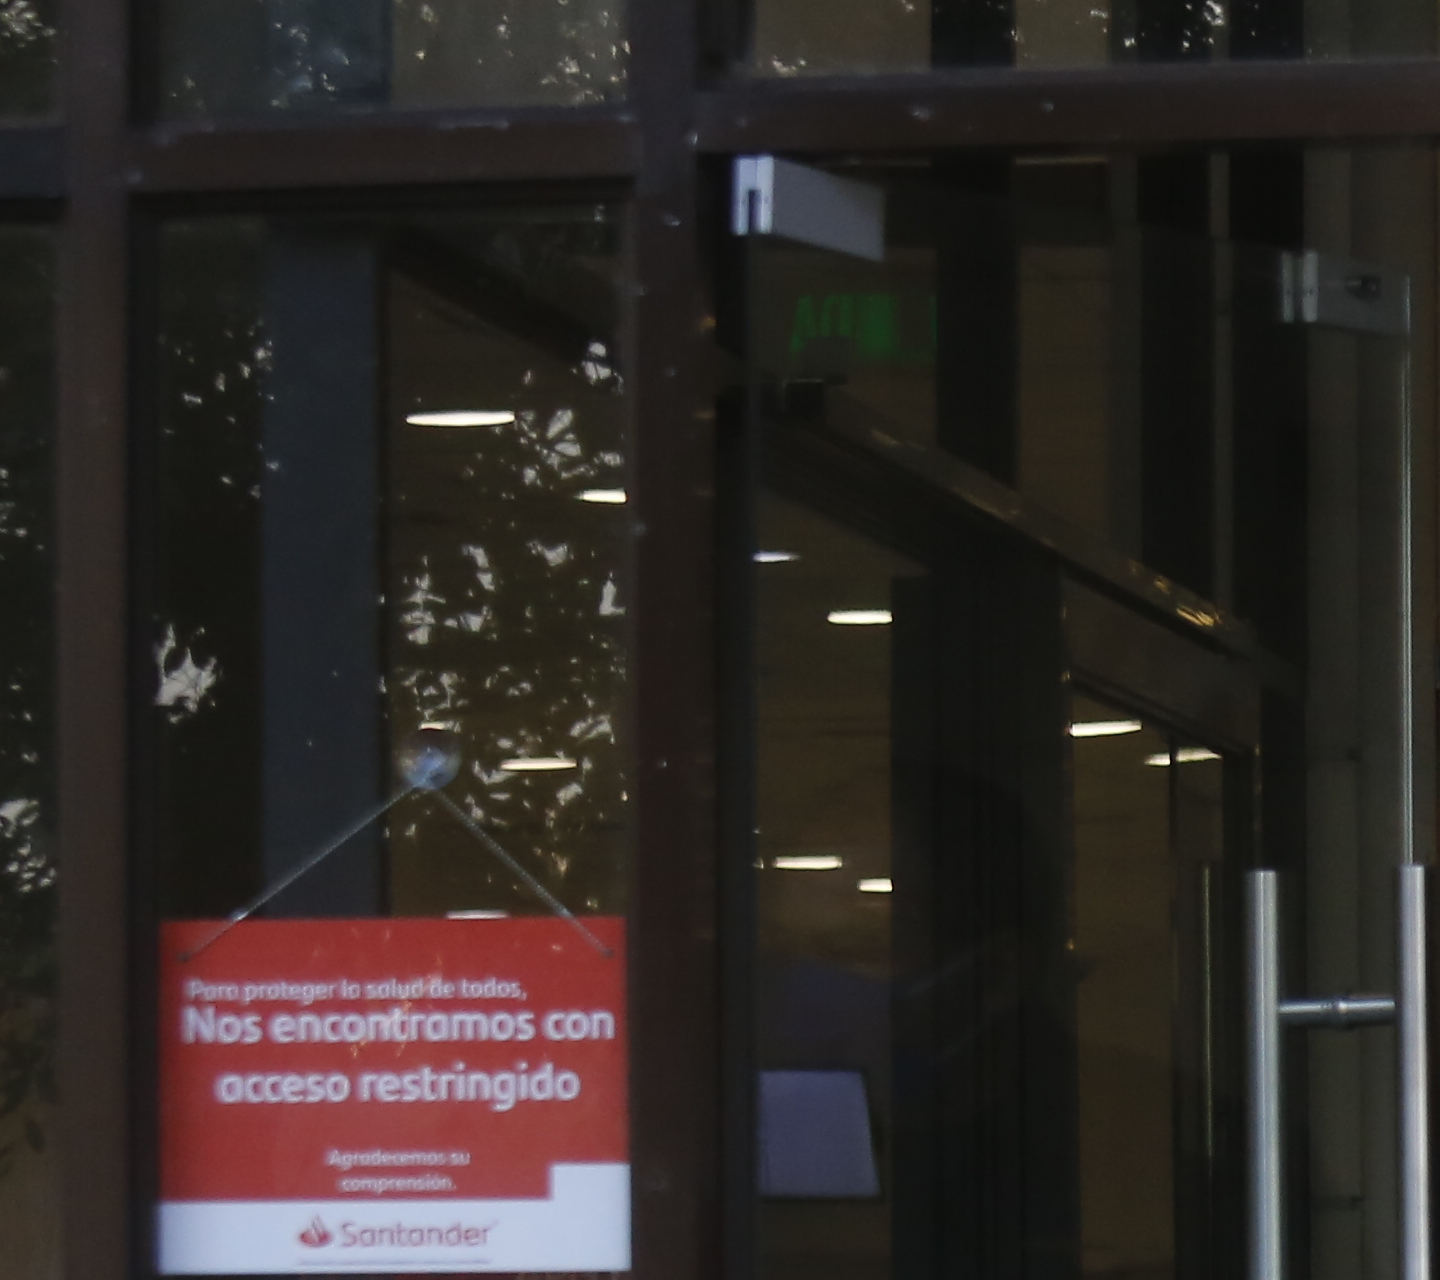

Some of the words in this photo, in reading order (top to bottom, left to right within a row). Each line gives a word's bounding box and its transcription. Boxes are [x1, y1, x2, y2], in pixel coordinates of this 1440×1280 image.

[186, 980, 235, 1000] Para
[243, 981, 334, 1005] proteger
[339, 980, 361, 999] la
[366, 978, 423, 999] salud
[428, 980, 455, 999] de
[460, 979, 527, 1000] todos,
[182, 1007, 263, 1043] Nos
[274, 1010, 535, 1043] encontramos
[543, 1010, 615, 1040] con
[215, 1070, 350, 1103] acceso
[358, 1062, 581, 1111] restringido
[326, 1148, 446, 1167] Agradecemos
[450, 1150, 471, 1165] su
[341, 1222, 490, 1248] Santander
